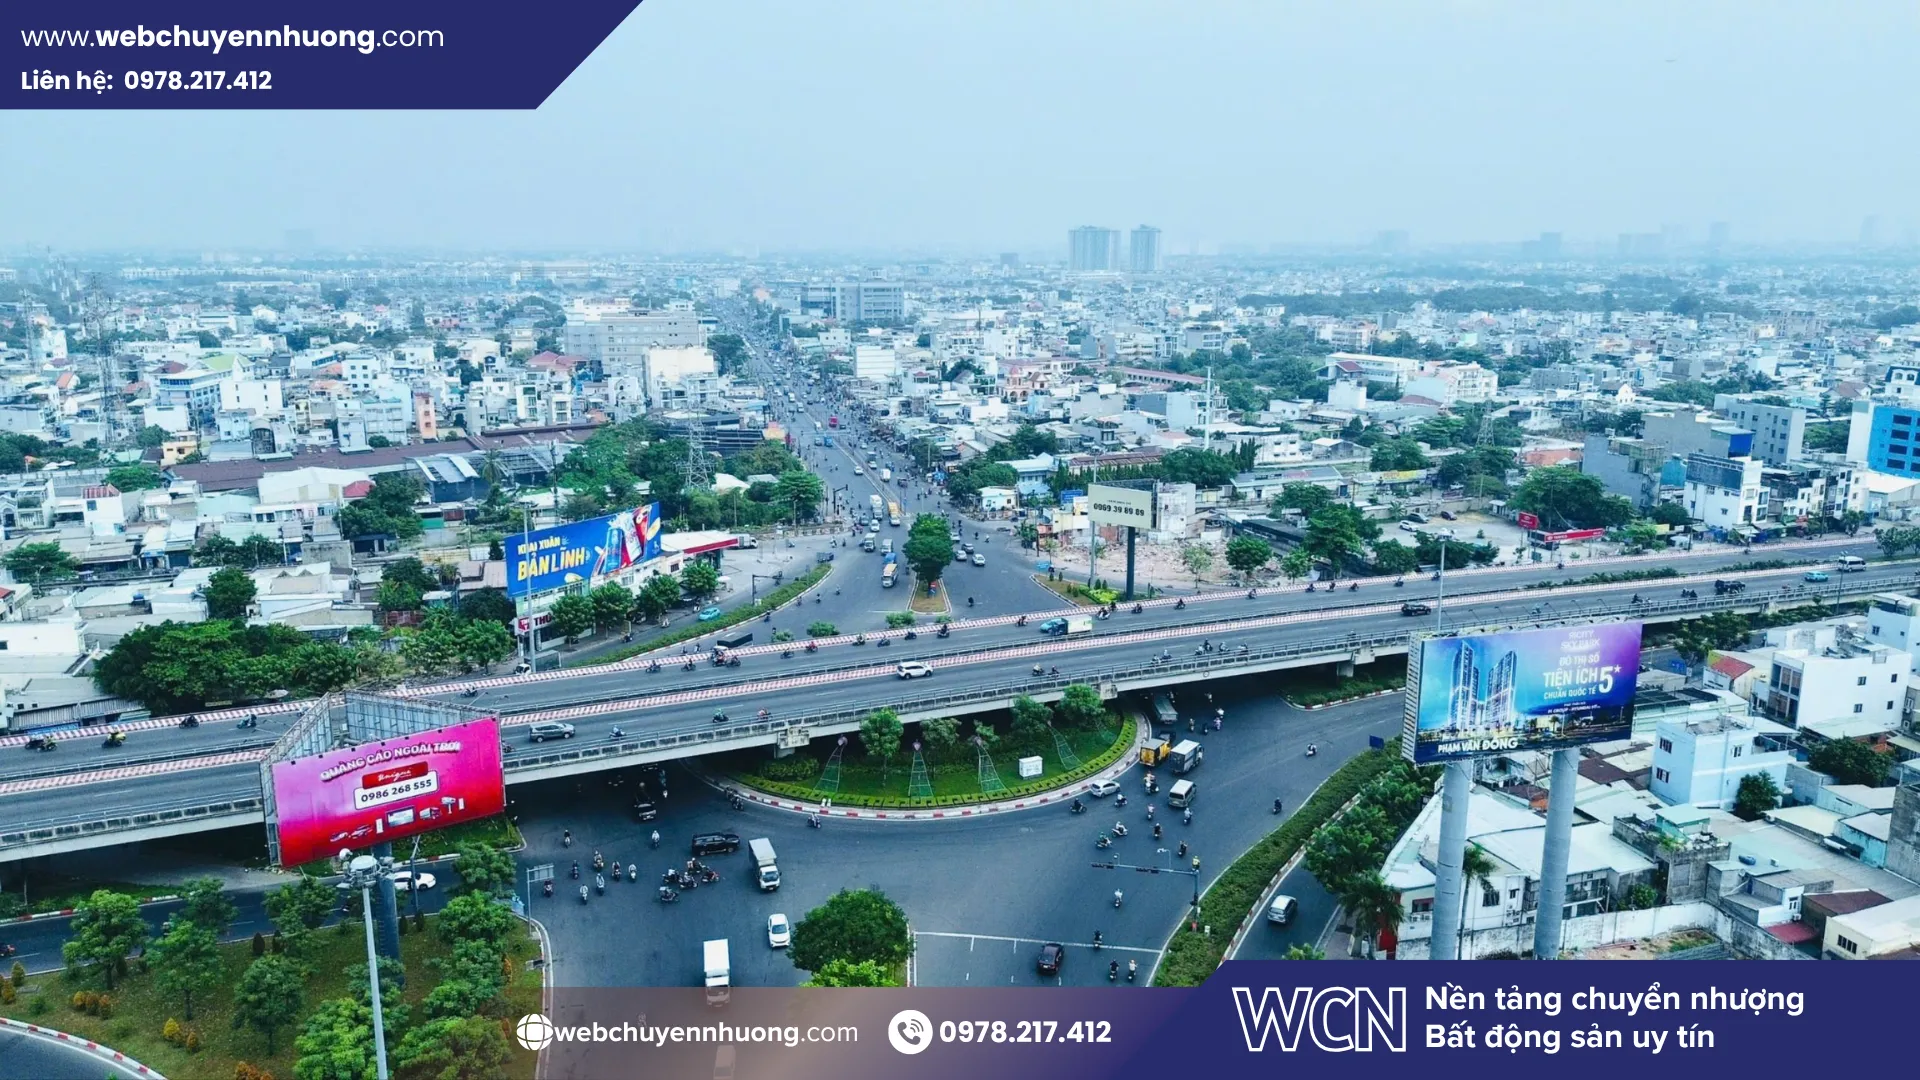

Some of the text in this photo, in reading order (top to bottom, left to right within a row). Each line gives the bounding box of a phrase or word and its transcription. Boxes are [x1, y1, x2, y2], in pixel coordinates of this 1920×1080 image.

[517, 546, 585, 581] BẢN LĨNH
[1543, 665, 1614, 693] TIỆN ÍCH 5
[1543, 687, 1567, 700] CHUẨN
[1437, 736, 1518, 755] PHẠM VĂN ĐỒNG
[320, 758, 366, 781] QUẢNG
[367, 749, 392, 766] CÁO
[361, 778, 432, 802] 0986 268 555
